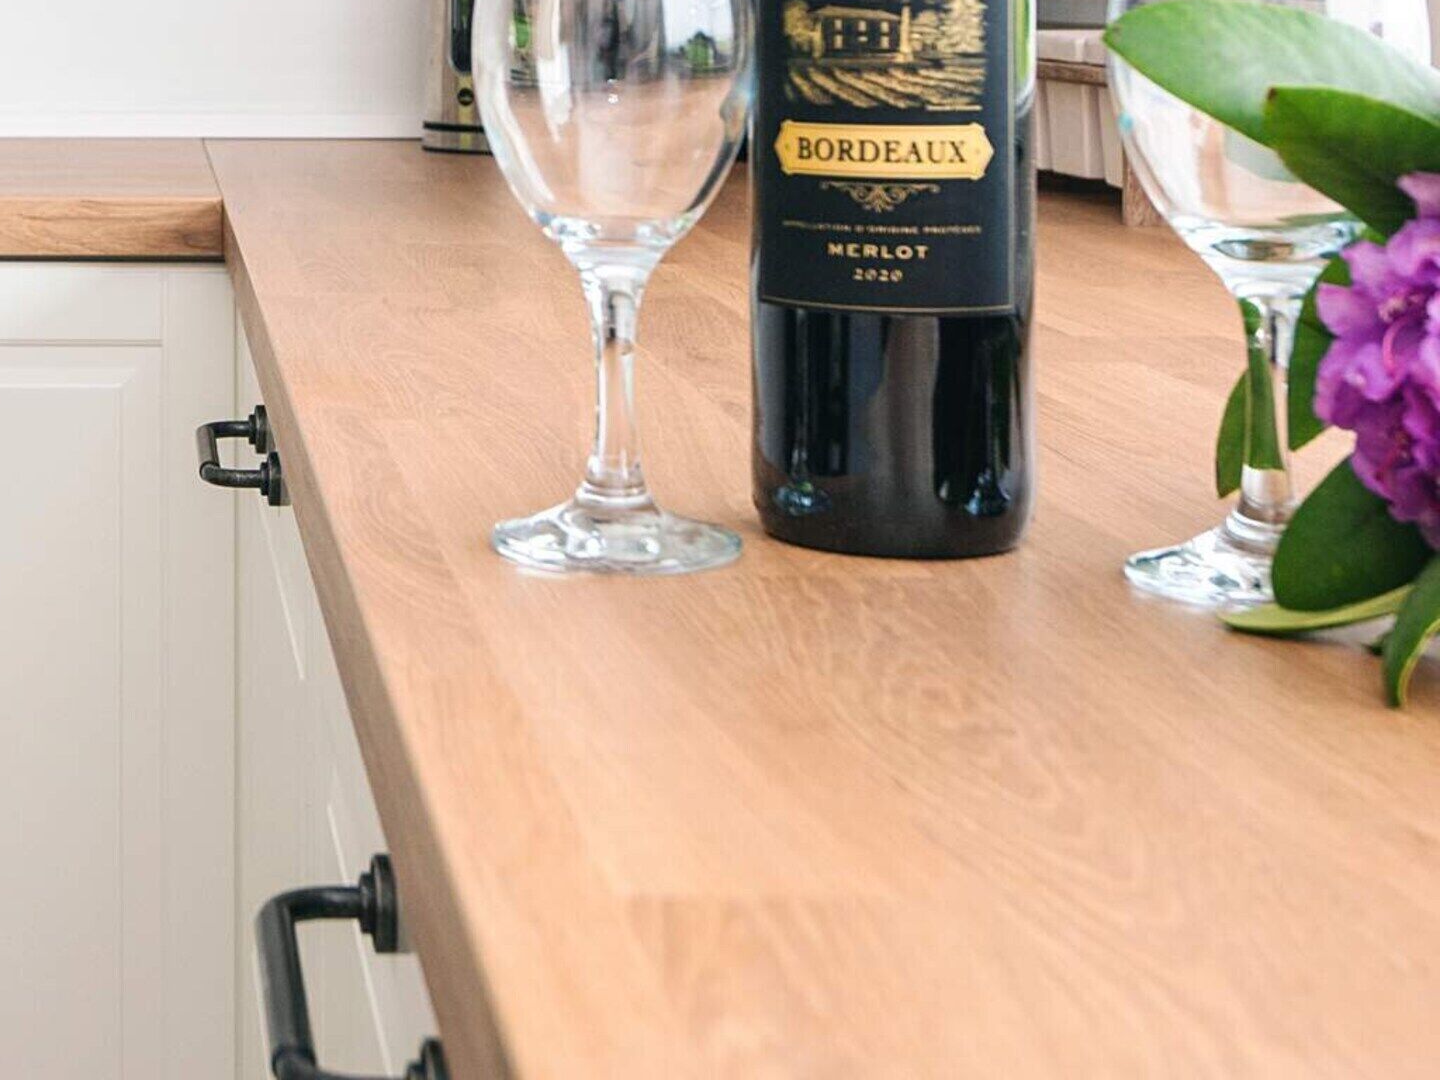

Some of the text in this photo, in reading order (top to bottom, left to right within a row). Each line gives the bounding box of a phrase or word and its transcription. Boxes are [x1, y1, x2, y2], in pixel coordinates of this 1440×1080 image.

[797, 135, 967, 164] BORDEAUX
[826, 242, 929, 260] MERLOT
[852, 267, 904, 282] 2020
